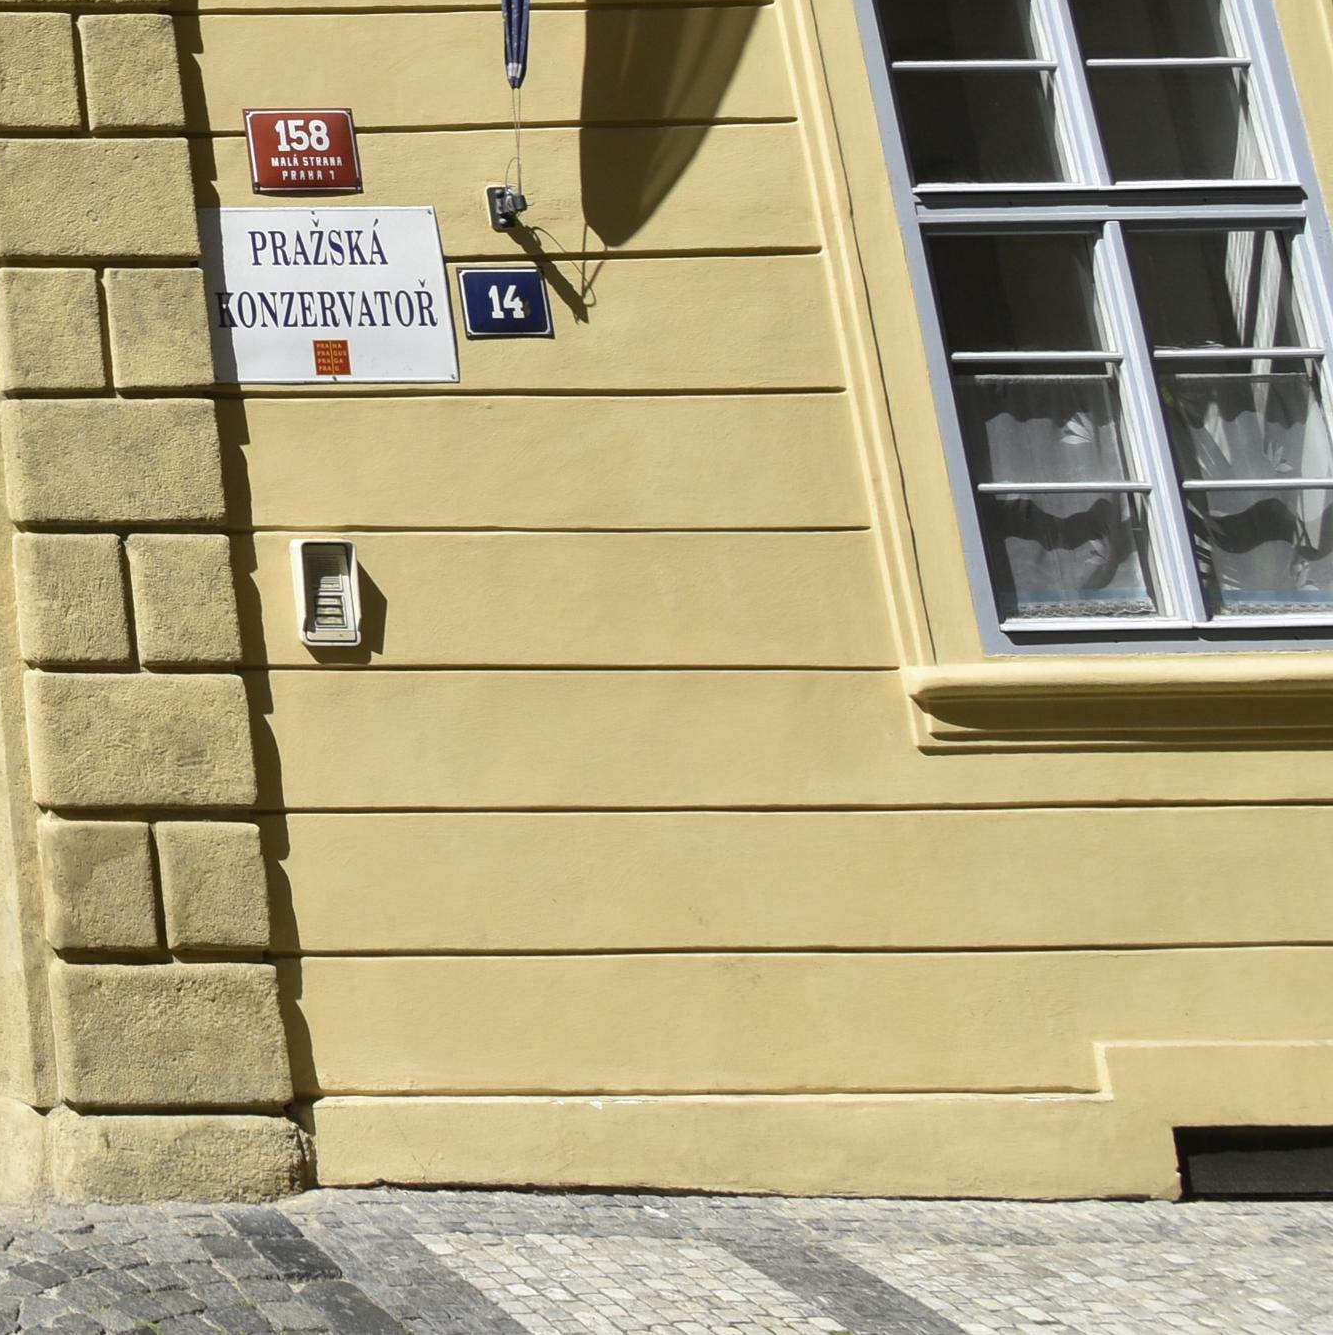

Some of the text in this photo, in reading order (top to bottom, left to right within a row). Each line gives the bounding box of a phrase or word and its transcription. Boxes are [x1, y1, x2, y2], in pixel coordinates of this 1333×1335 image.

[275, 119, 330, 151] 158
[271, 154, 342, 167] MALÁ STRANA
[282, 170, 335, 181] PRAHA 1
[248, 218, 389, 267] PRAŽSKÁ
[215, 278, 438, 328] KONZERVATOŘ
[487, 284, 526, 320] 14
